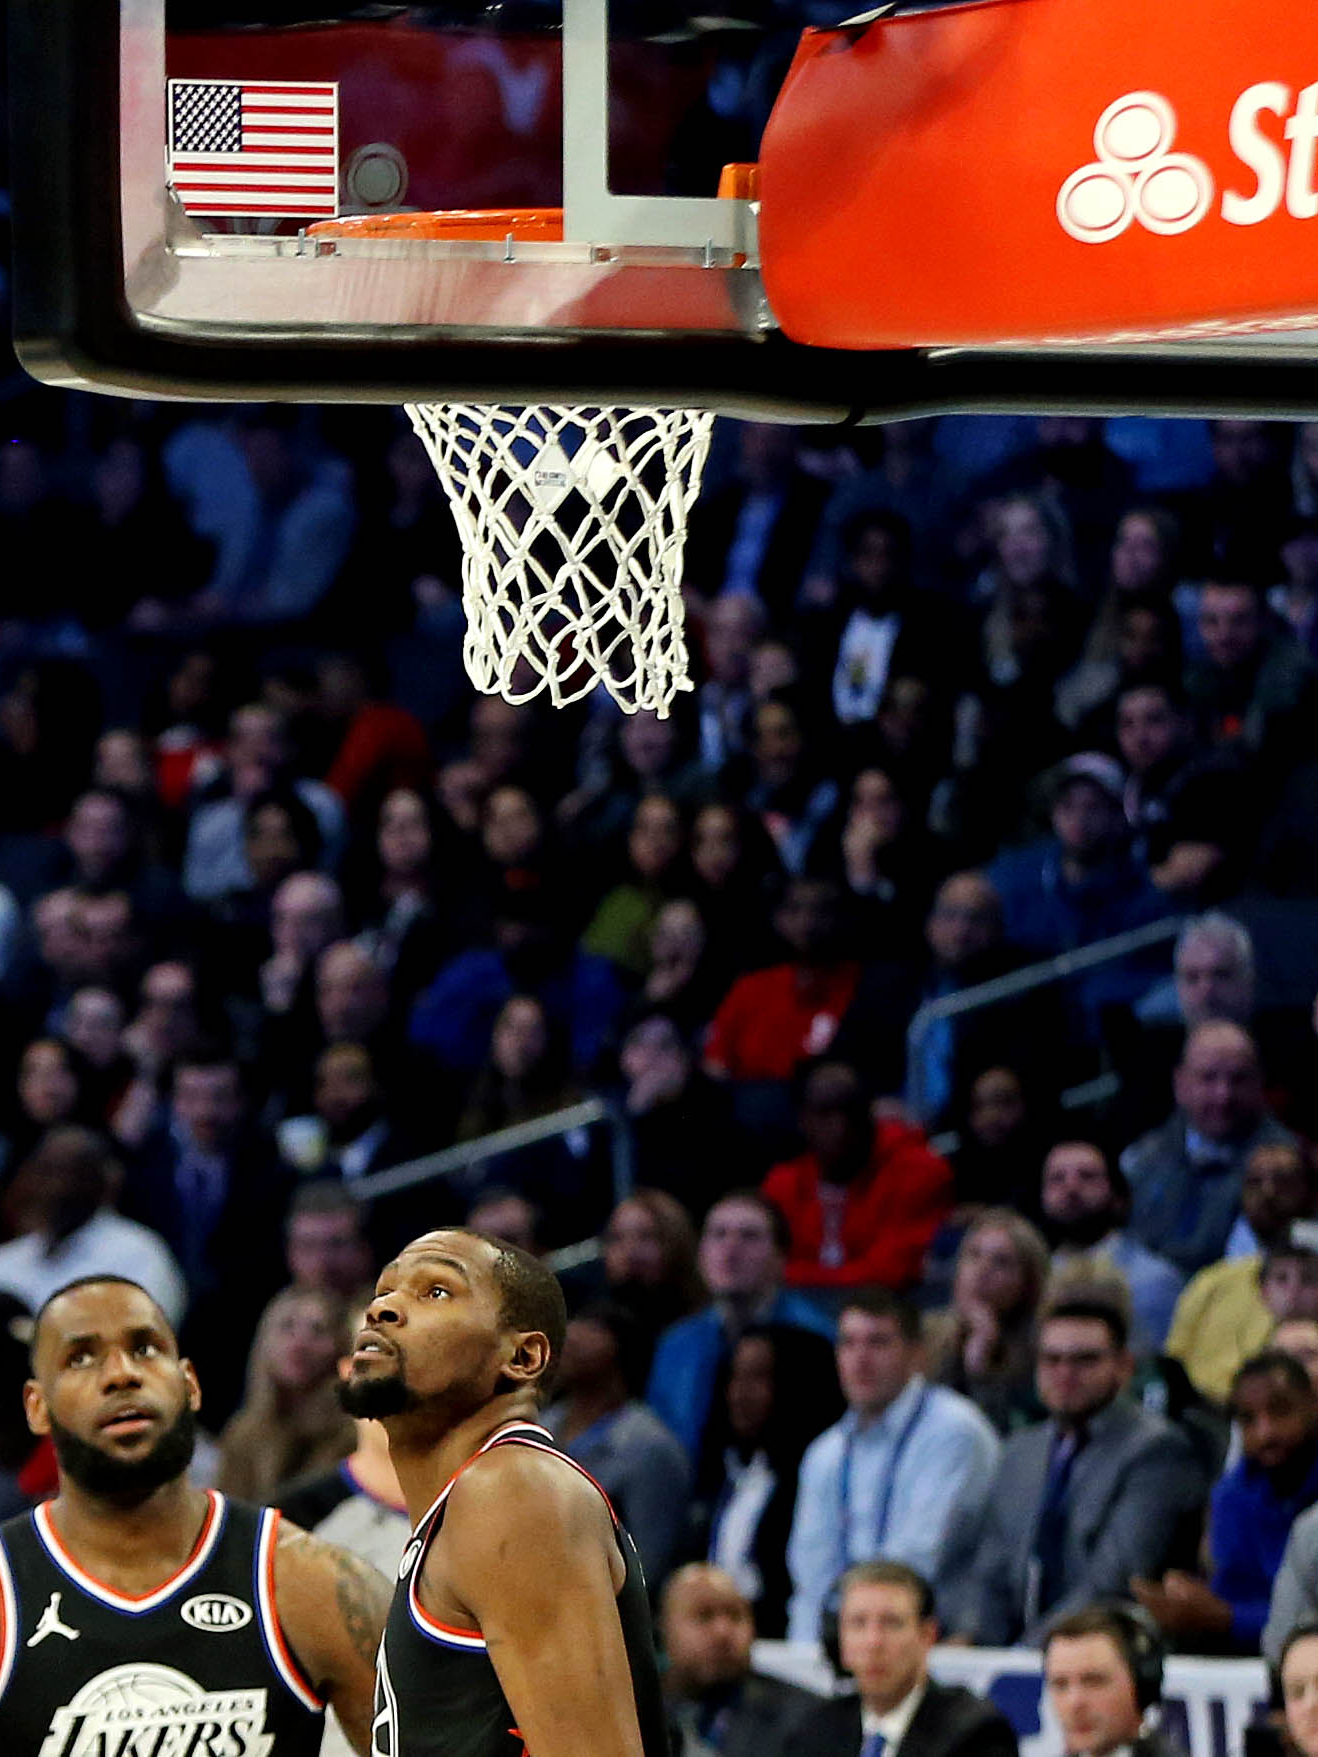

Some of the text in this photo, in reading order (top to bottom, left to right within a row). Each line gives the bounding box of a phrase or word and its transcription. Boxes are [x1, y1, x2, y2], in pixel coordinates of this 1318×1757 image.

[191, 1600, 243, 1625] KIA
[105, 1698, 254, 1723] LOS ANGELES
